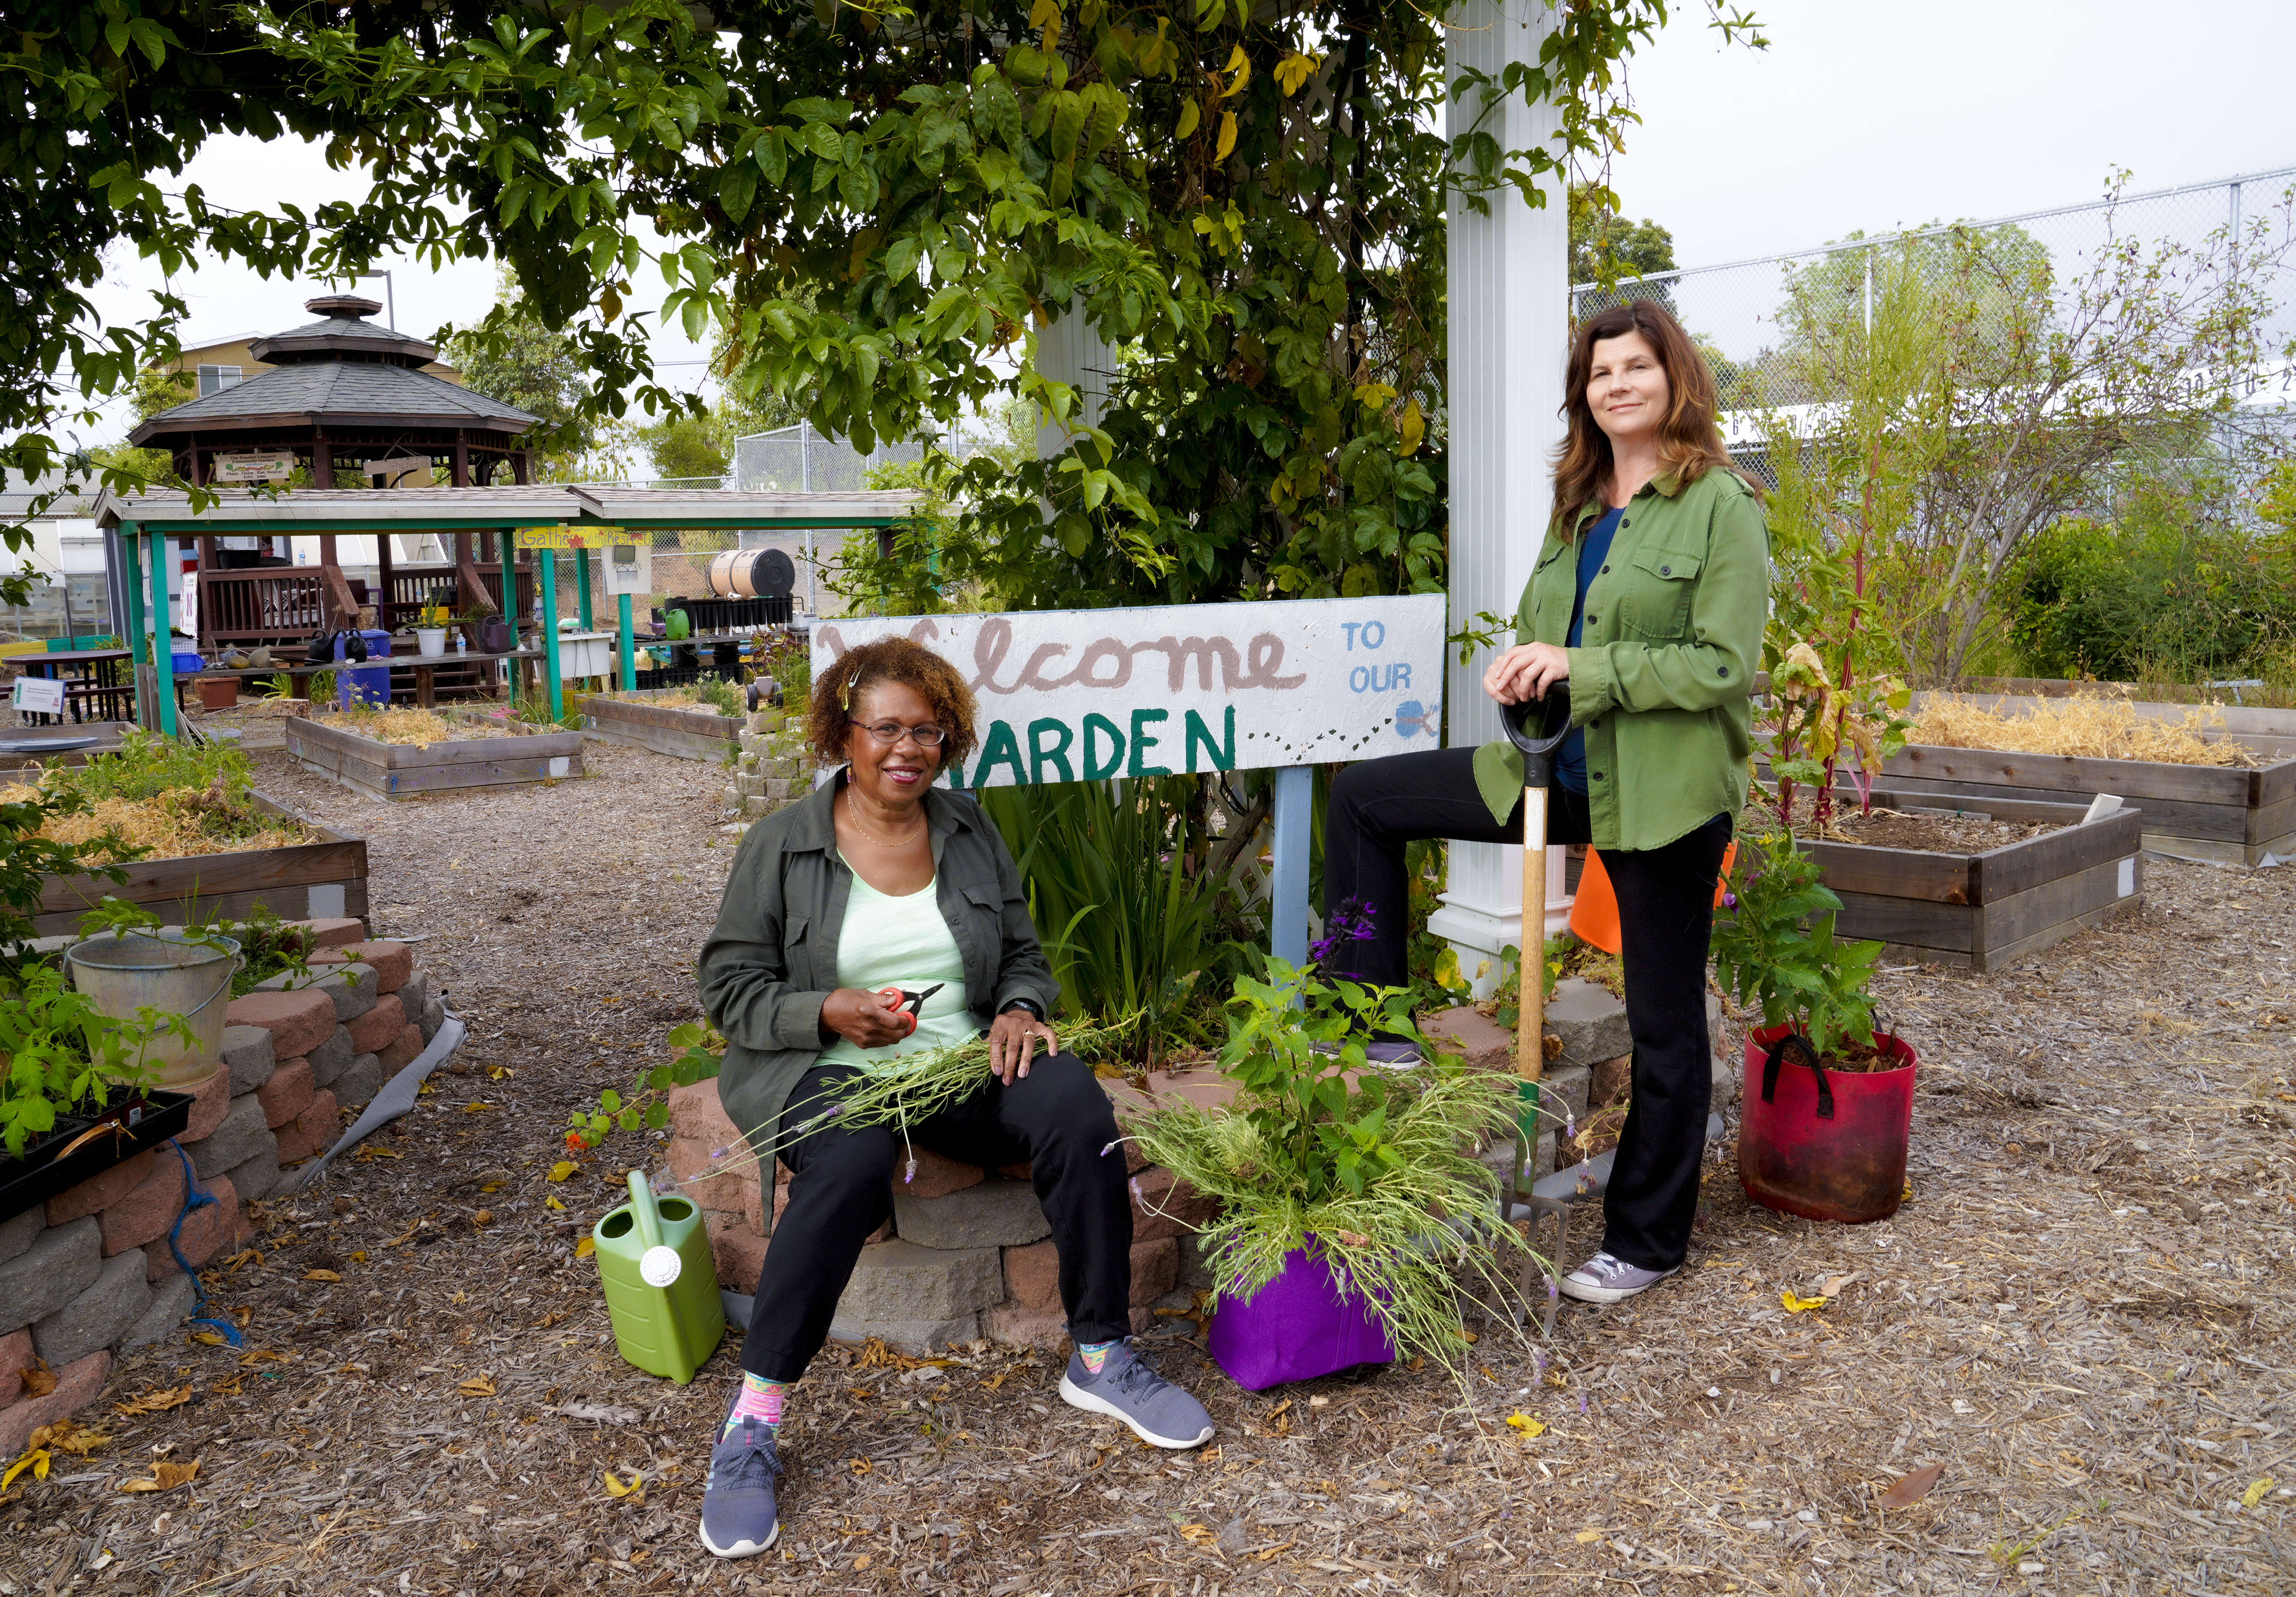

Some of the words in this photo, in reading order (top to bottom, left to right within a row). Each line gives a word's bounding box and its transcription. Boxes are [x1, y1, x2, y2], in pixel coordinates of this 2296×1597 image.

[1733, 419, 1739, 435] 6
[521, 528, 574, 546] Gather
[583, 532, 603, 545] with
[608, 531, 648, 546] Respect
[1341, 620, 1385, 651] TO
[816, 618, 1307, 694] lcome
[1349, 662, 1412, 694] OUR
[933, 704, 1236, 790] ARDEN
